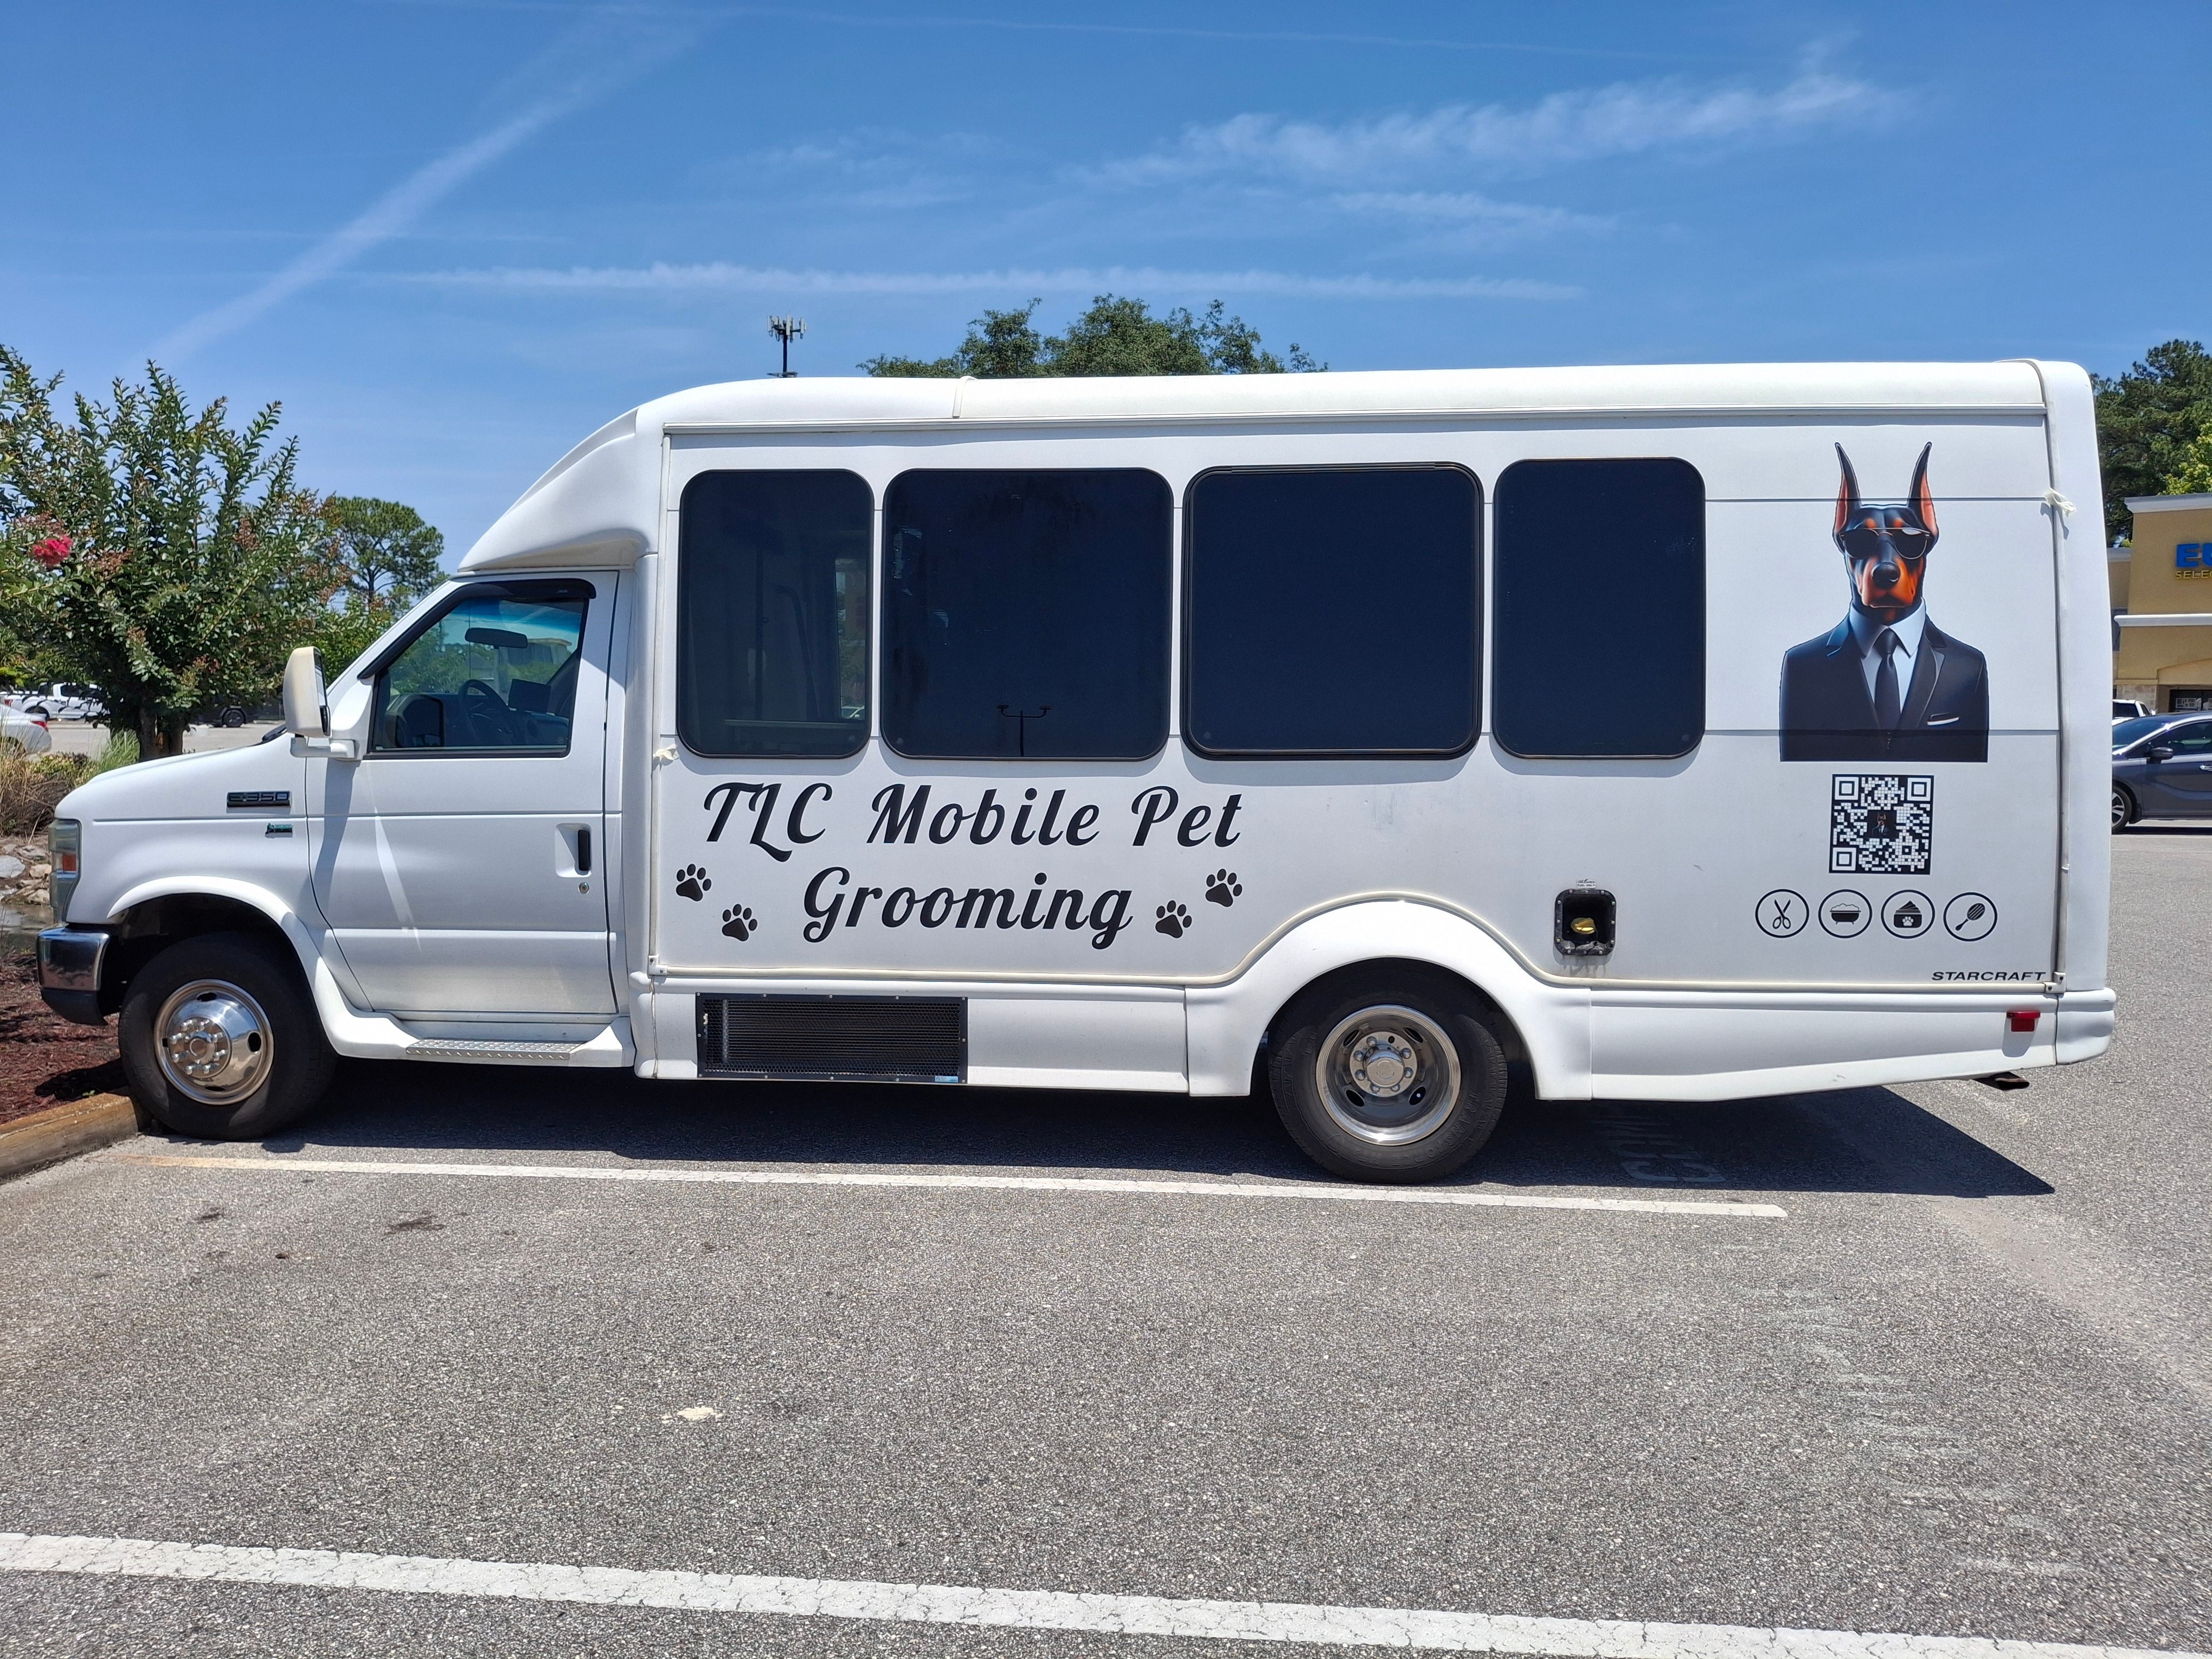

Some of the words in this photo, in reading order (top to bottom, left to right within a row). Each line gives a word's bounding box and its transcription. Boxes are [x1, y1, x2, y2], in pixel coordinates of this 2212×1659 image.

[704, 782, 832, 863] TLC
[866, 783, 1099, 846] Mobile
[1131, 786, 1242, 847] Pet
[803, 866, 1134, 950] Grooming
[1932, 972, 2047, 981] STARCRAFT
